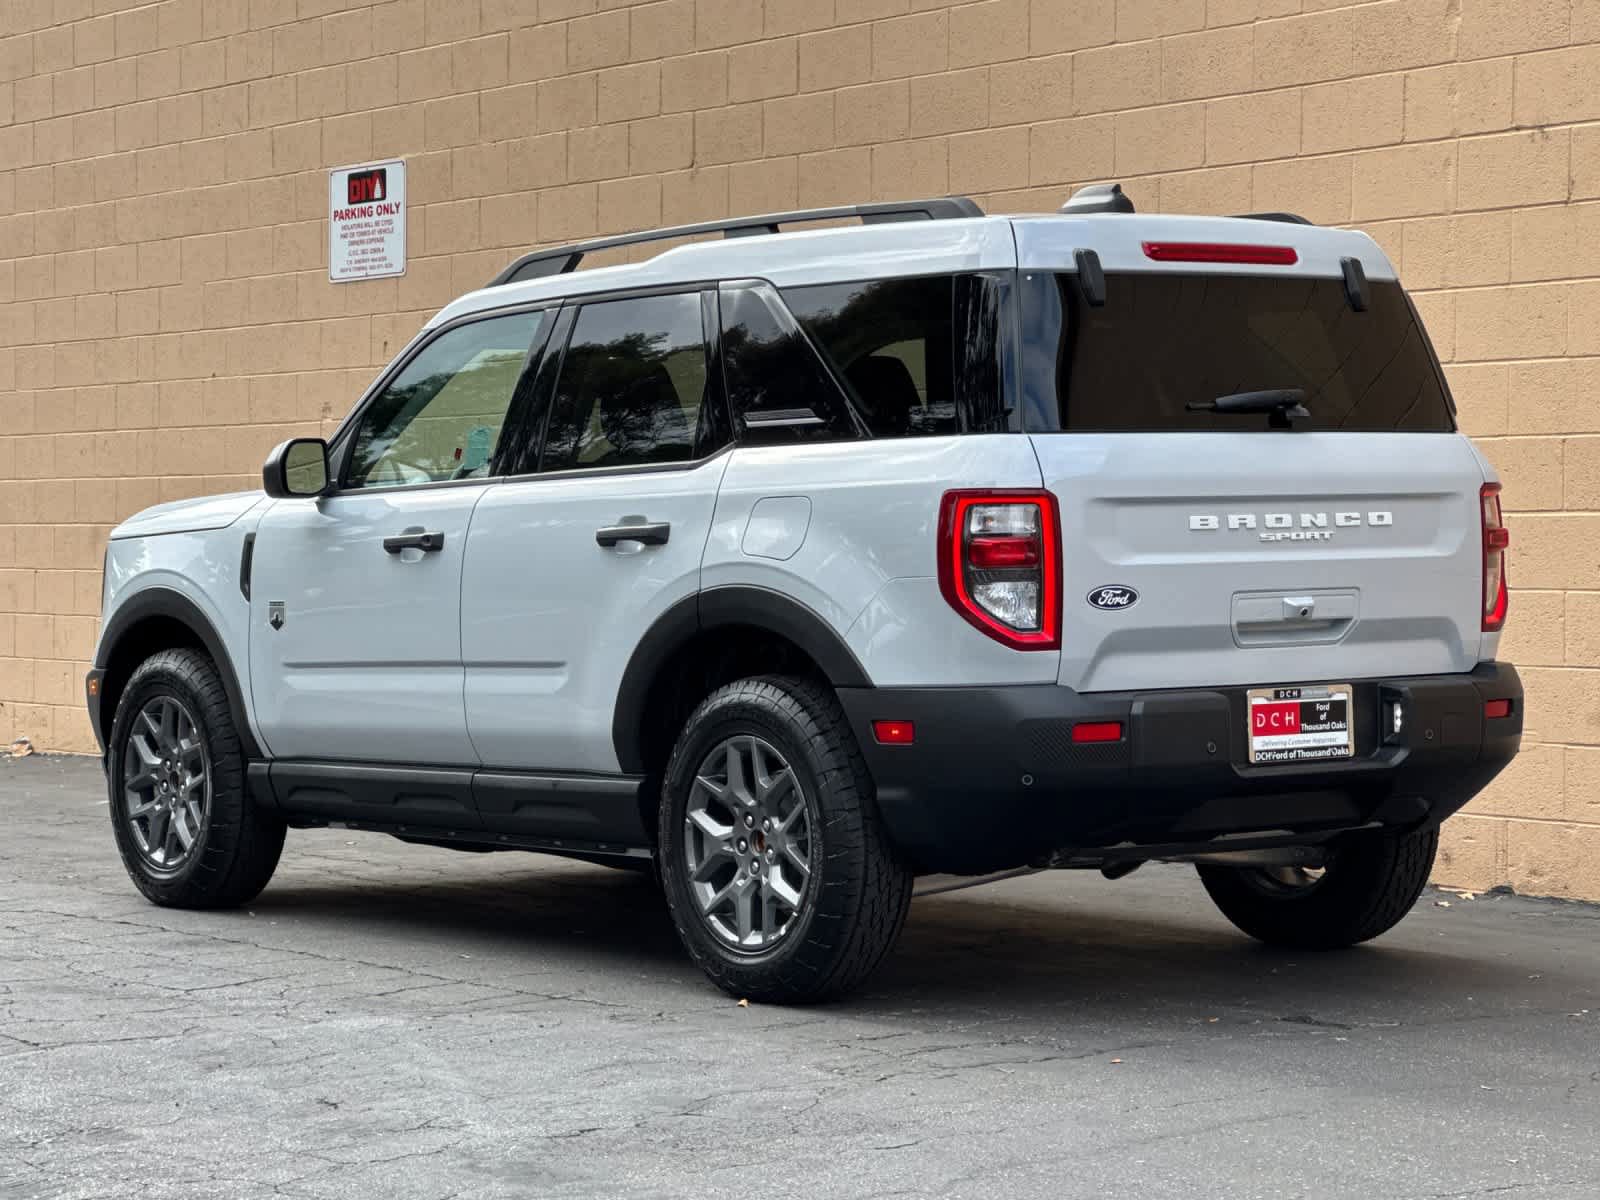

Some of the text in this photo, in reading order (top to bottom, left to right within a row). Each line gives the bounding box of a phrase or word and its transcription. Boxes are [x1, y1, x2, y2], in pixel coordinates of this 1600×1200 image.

[333, 201, 401, 222] PARKING ONLY
[1189, 512, 1393, 530] BRONCO
[1259, 531, 1335, 542] SPORT
[1098, 590, 1130, 605] Ford
[1316, 703, 1330, 712] Ford
[1256, 712, 1295, 728] DCH
[1319, 712, 1327, 720] of
[1301, 720, 1346, 732] Thousand Oaks
[1289, 749, 1297, 759] of
[1297, 747, 1330, 757] Thousand
